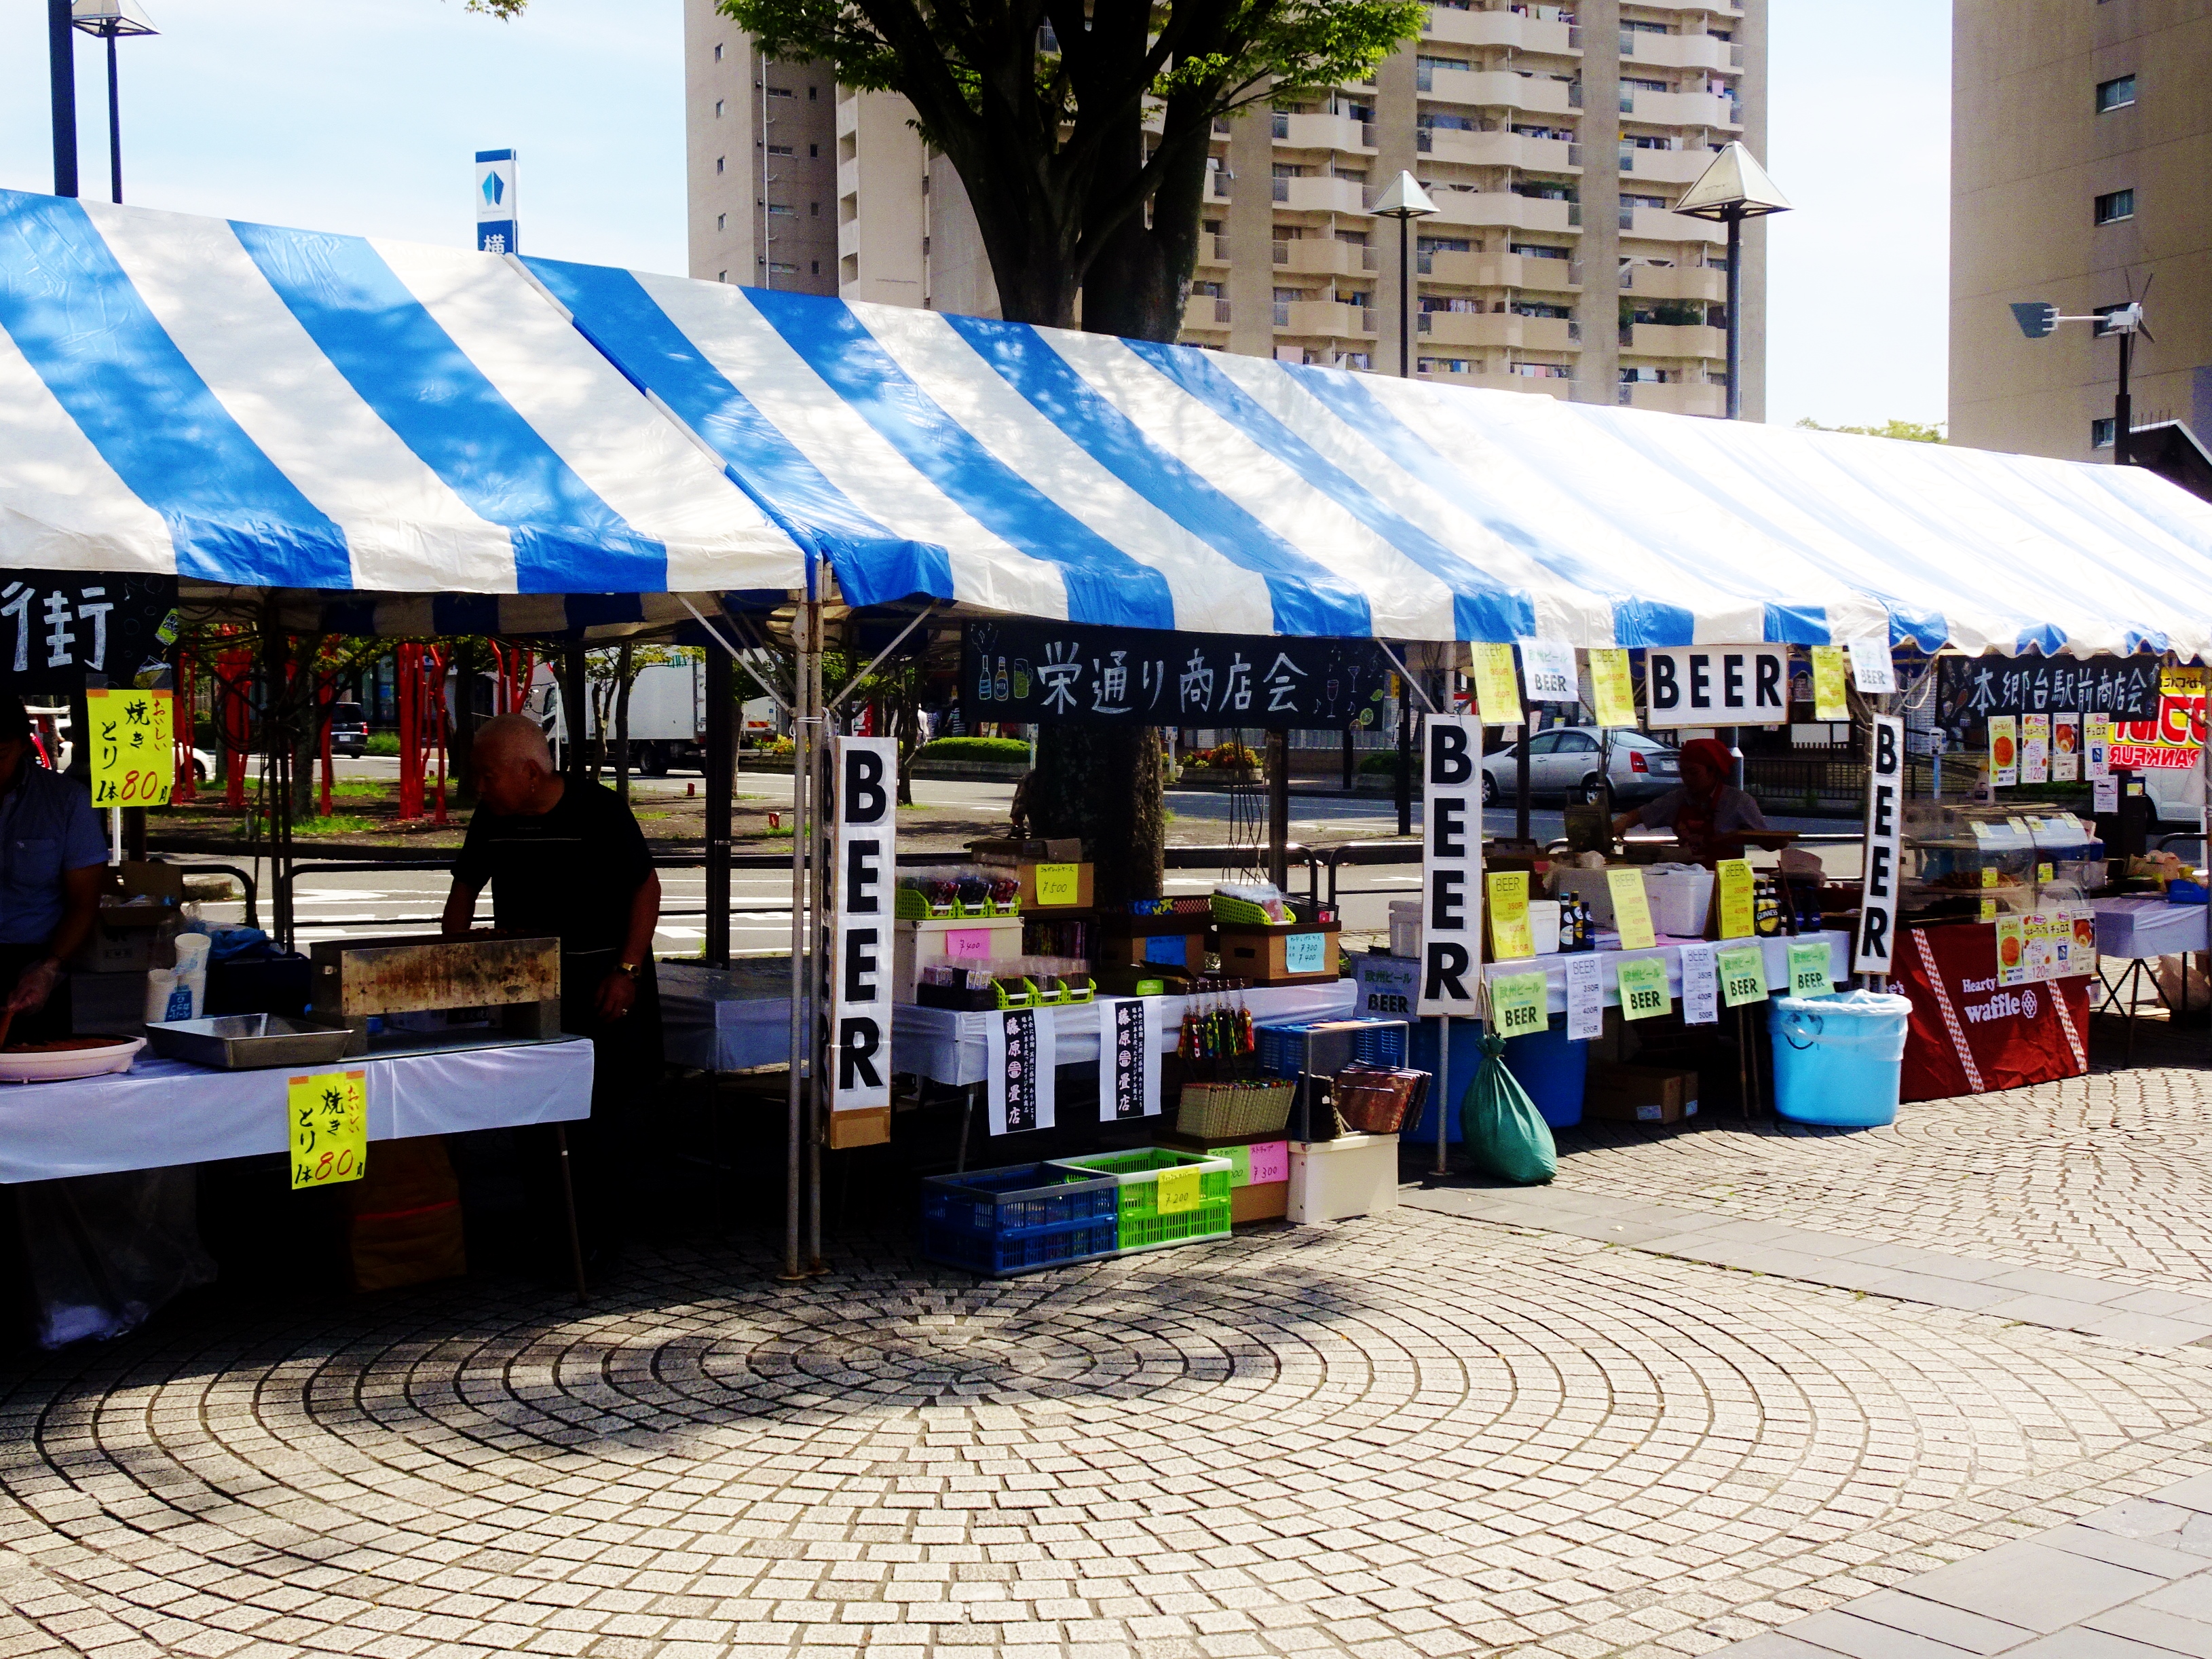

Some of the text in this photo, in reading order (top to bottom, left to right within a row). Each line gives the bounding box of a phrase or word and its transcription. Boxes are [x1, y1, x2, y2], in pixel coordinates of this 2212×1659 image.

[484, 234, 505, 253] 横
[0, 581, 114, 672] 街
[1478, 642, 1503, 657] BEER
[1596, 648, 1620, 663] BEER
[1037, 640, 1309, 715] 栄通り商店会
[1535, 673, 1567, 692] BEER
[1651, 654, 1782, 709] BEER
[1860, 669, 1886, 684] BEER
[1968, 667, 2148, 717] 本郷台駅前商店会
[124, 698, 151, 749] 焼き
[153, 698, 168, 751] おいしい
[2086, 727, 2106, 736] チュロス
[101, 721, 117, 770] とり
[1861, 723, 1897, 958] BEER
[1424, 724, 1472, 1000] BEER
[1725, 863, 1746, 878] BEER
[1043, 880, 1068, 895] ¥500
[1496, 877, 1520, 892] BEER
[1614, 874, 1636, 887] BEER
[839, 749, 886, 1090] BEER
[2050, 924, 2069, 933] チュロス
[1687, 948, 1710, 962] BEER
[1573, 960, 1596, 975] BEER
[1729, 977, 1758, 996] BEER
[1798, 972, 1825, 989] BEER
[1962, 977, 1996, 993] Hearty
[1368, 994, 1409, 1013] BEER
[1630, 990, 1662, 1010] BEER
[1964, 992, 2021, 1024] waffle
[1505, 1007, 1537, 1027] BEER
[320, 1086, 345, 1136] 焼き
[348, 1085, 360, 1134] おいしい
[299, 1108, 316, 1154] とり
[1254, 1166, 1277, 1181] ¥300
[1166, 1193, 1188, 1206] ¥200
